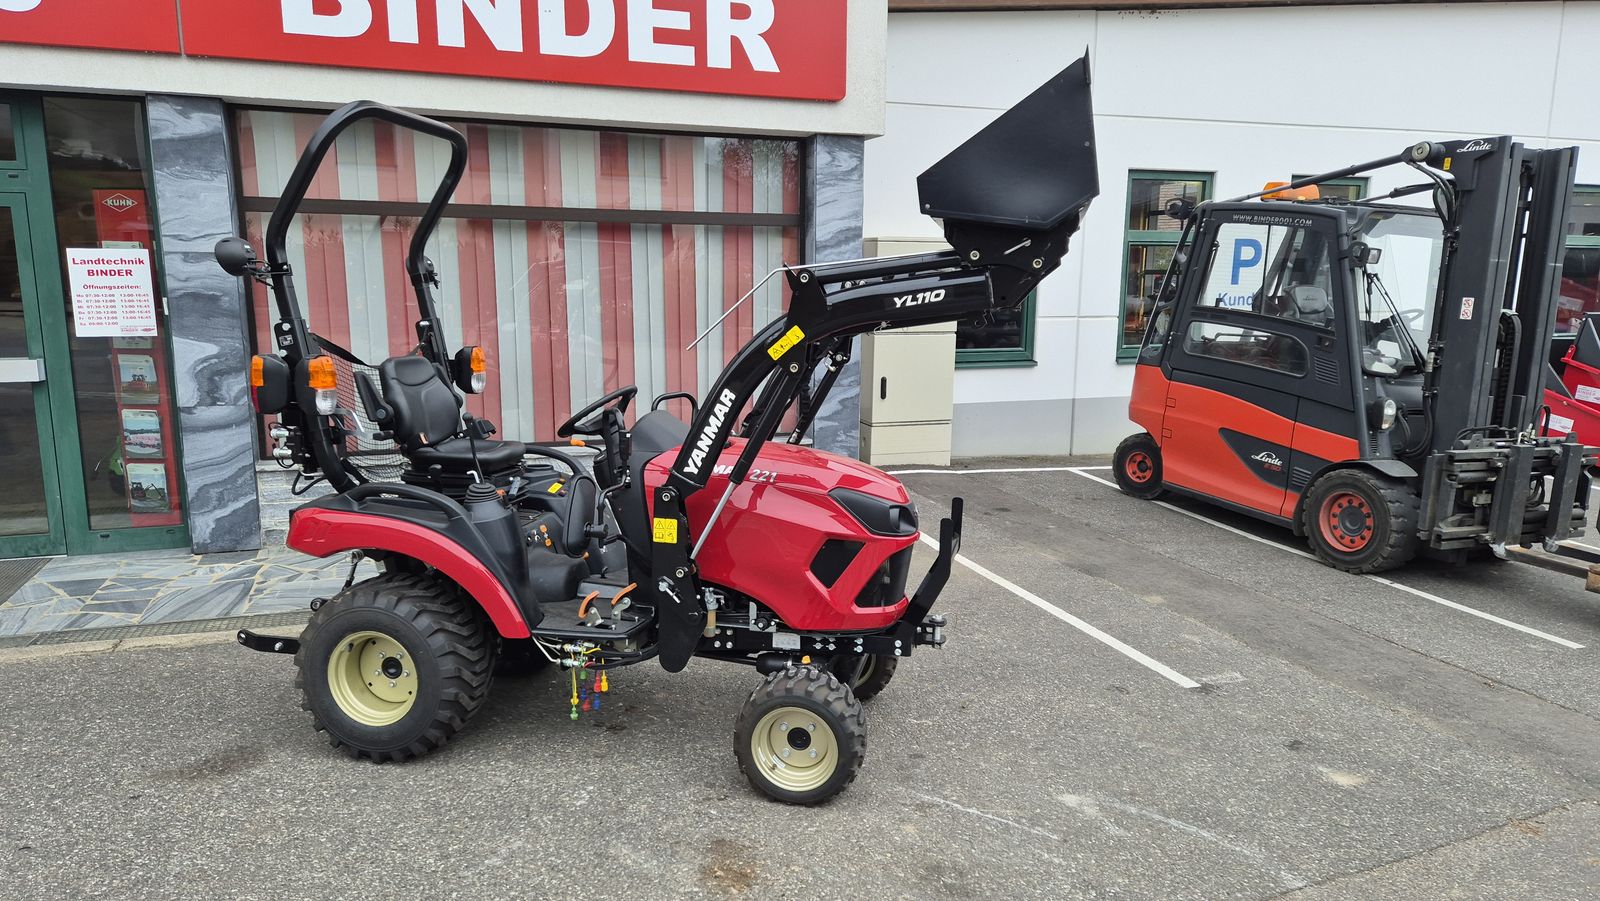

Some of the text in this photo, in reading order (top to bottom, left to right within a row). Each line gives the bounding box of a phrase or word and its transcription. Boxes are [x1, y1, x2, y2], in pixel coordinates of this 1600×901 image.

[1457, 139, 1492, 152] Linde
[72, 257, 145, 265] Landtechnik
[1231, 238, 1262, 285] P
[87, 269, 134, 277] BINDER
[893, 289, 946, 308] YL110
[683, 388, 736, 475] YANMAR
[1251, 451, 1283, 466] Linde
[749, 469, 778, 482] 221
